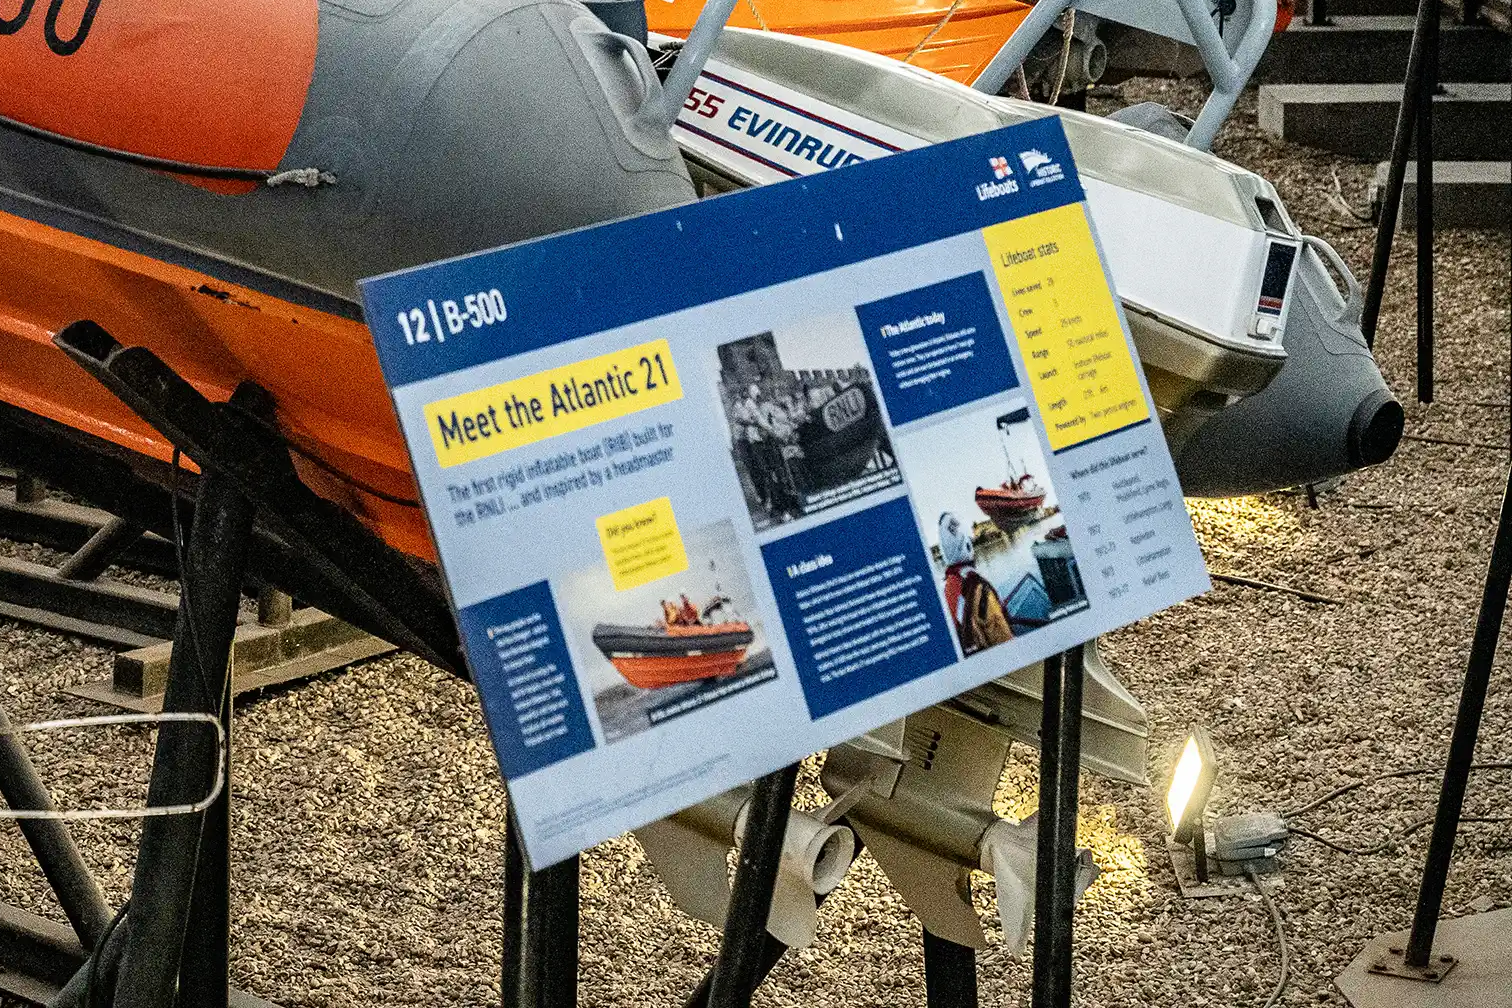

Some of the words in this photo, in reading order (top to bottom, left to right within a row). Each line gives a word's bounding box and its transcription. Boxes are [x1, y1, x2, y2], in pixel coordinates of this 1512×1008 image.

[975, 179, 1019, 201] Lifeboats
[1000, 244, 1036, 268] Lifeboat
[1036, 239, 1059, 258] stats
[397, 308, 431, 345] 12
[441, 288, 508, 334] B-500
[437, 410, 503, 450] Meet
[504, 394, 545, 429] the
[550, 364, 640, 417] Atlantic
[639, 352, 670, 390] 21
